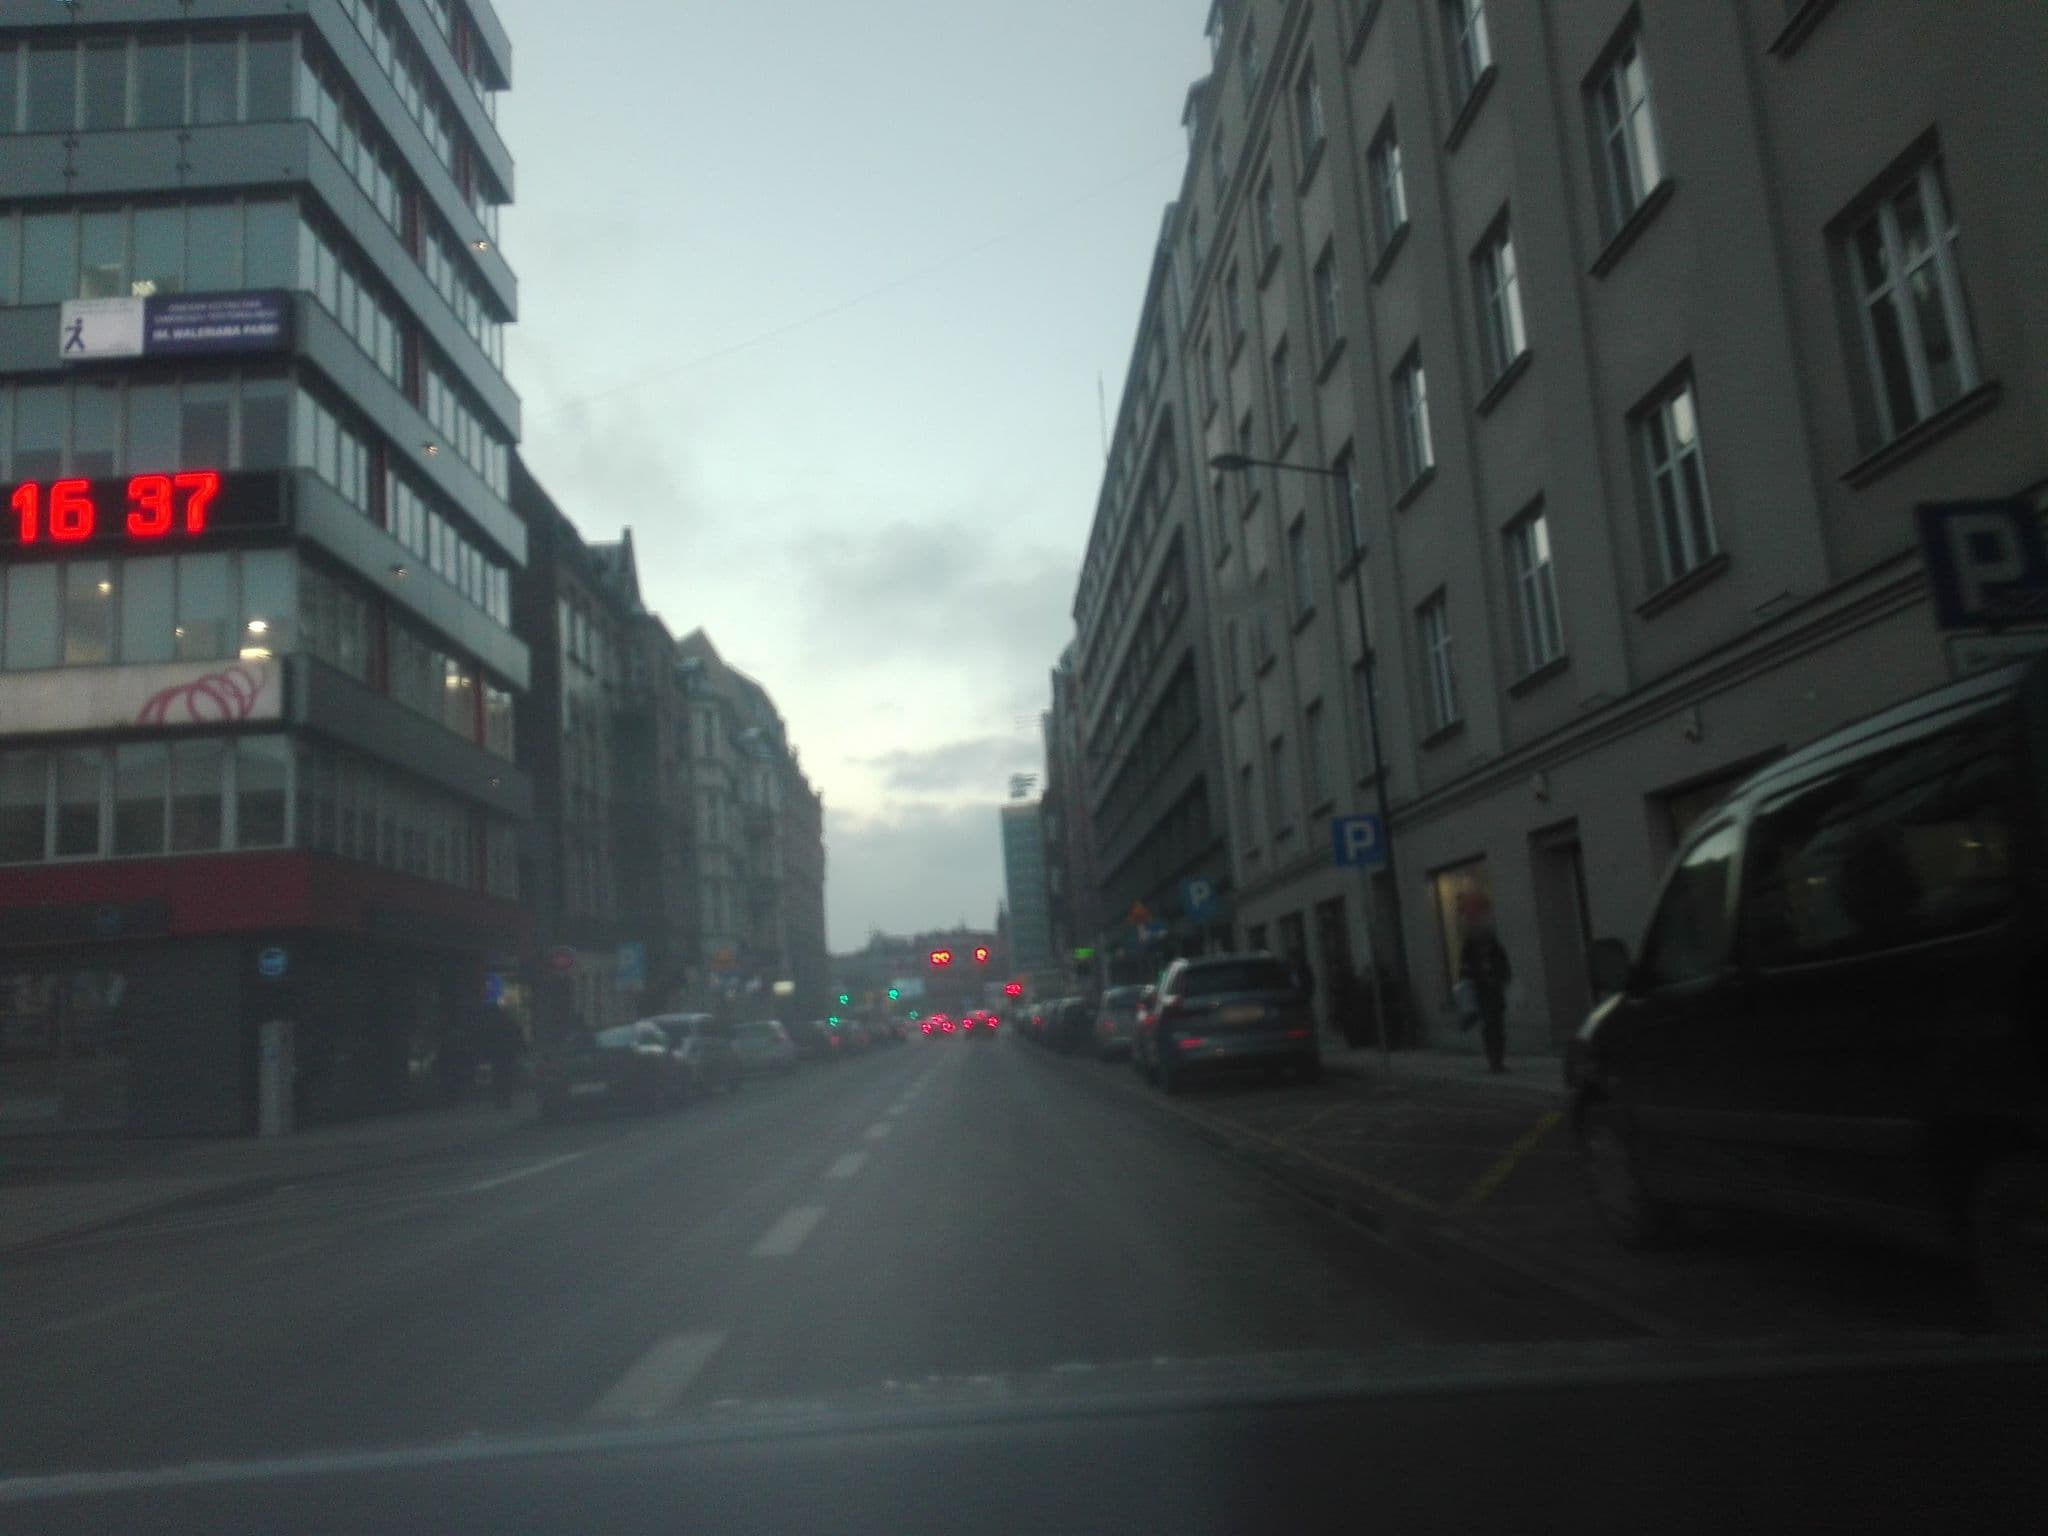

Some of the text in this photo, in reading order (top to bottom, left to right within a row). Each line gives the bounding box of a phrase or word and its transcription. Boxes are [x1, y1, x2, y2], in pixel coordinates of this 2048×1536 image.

[11, 472, 219, 543] 16 37
[1944, 513, 2024, 611] P
[1344, 821, 1376, 861] P
[1190, 879, 1211, 909] P
